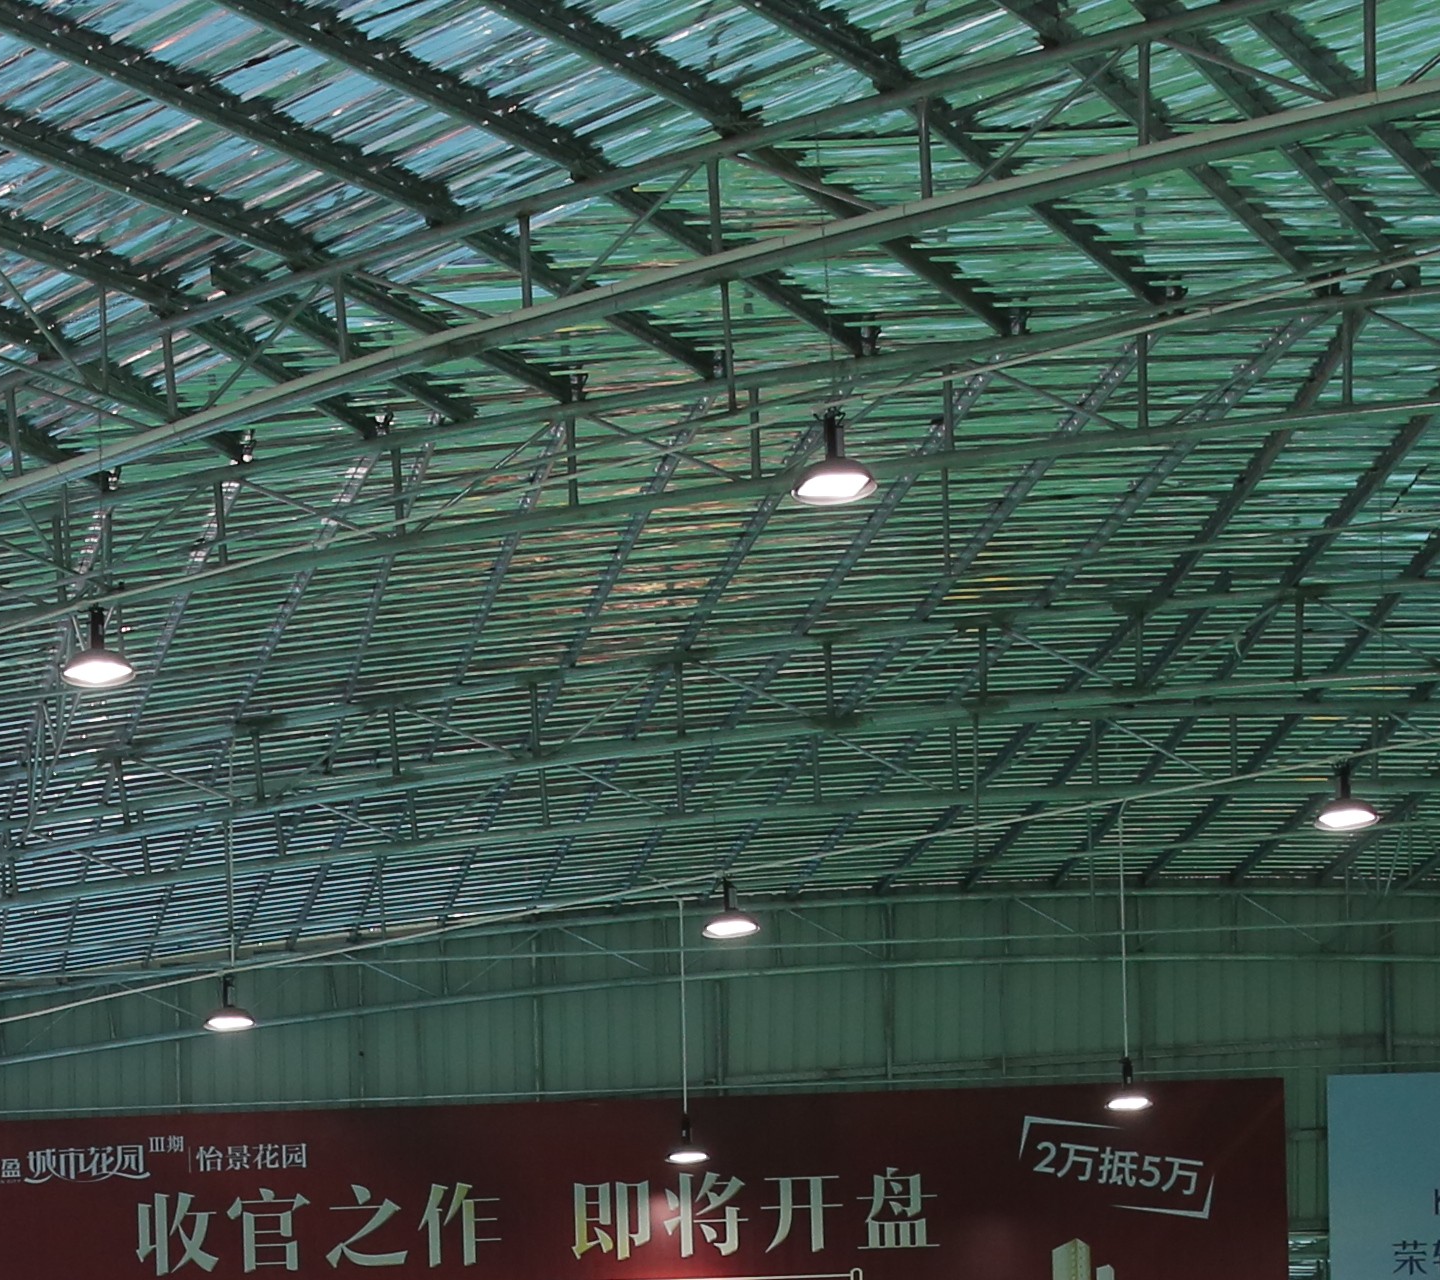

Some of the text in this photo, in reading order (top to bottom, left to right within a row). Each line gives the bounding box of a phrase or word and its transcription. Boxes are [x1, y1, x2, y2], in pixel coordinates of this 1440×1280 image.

[24, 1144, 151, 1184] 城市花园
[196, 1143, 308, 1171] 怡景花园
[1032, 1137, 1204, 1198] 2万抵5万
[136, 1167, 941, 1276] 收官之作 即将开盘
